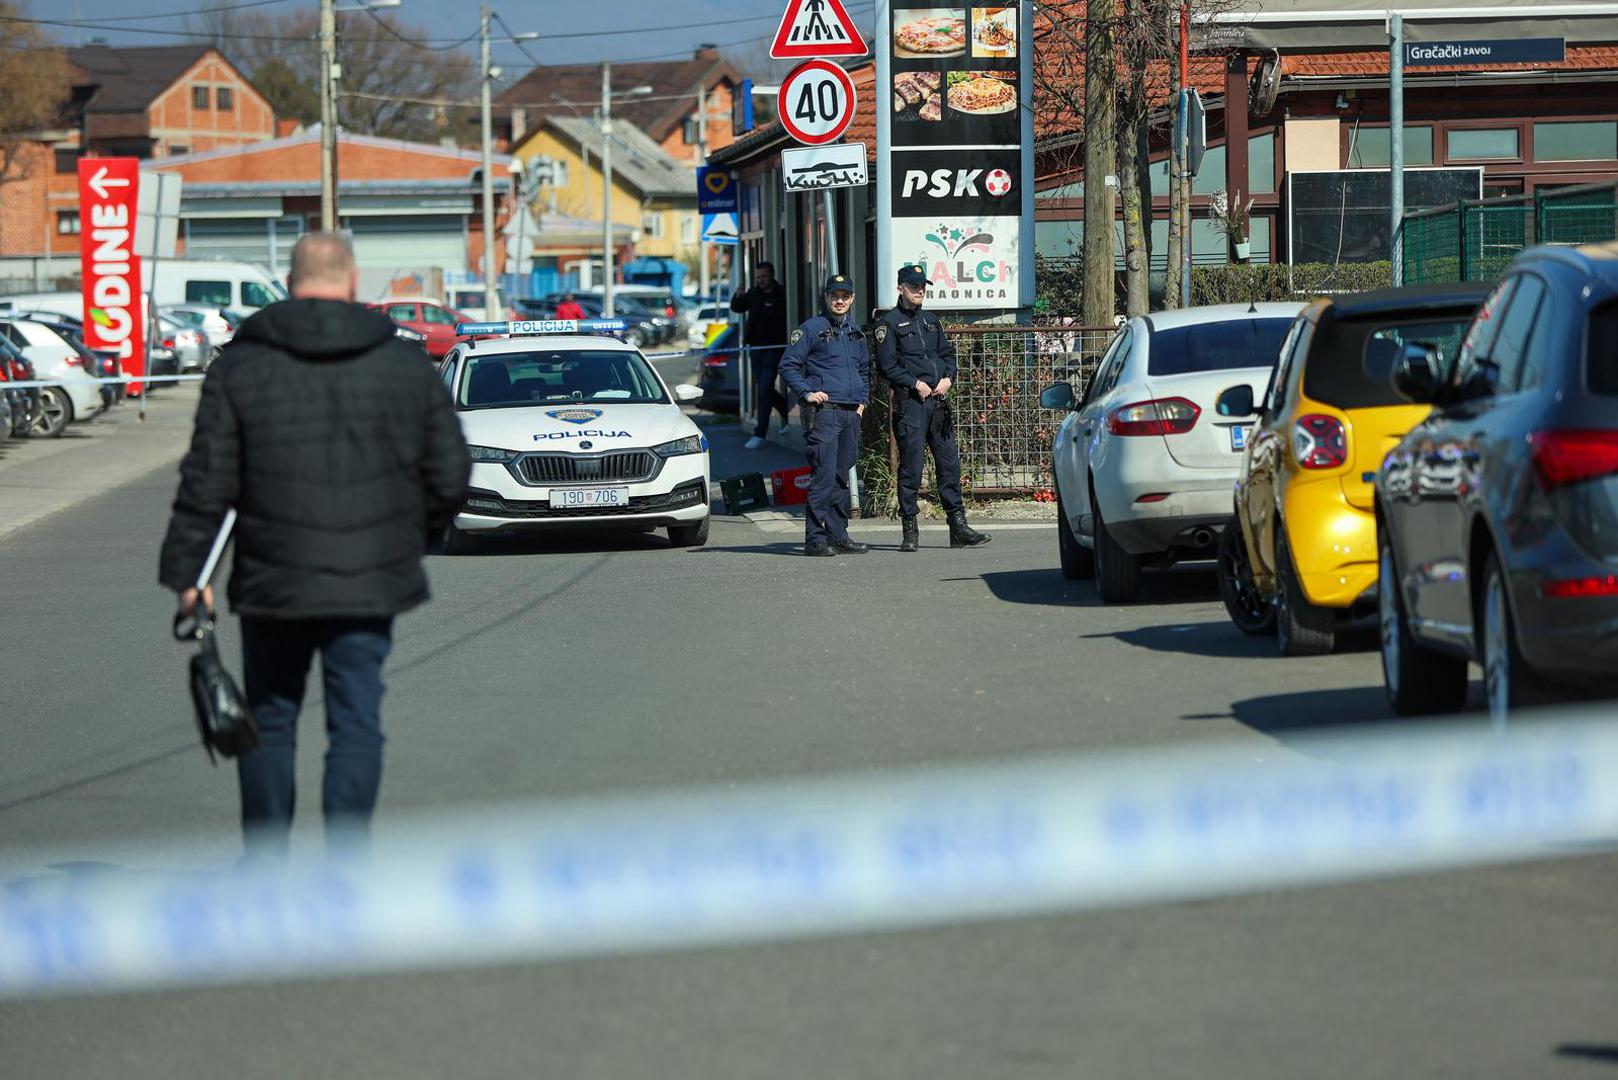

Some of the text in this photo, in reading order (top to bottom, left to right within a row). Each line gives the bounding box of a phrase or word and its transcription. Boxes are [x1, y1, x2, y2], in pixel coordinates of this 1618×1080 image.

[1411, 44, 1491, 60] Gračački ZAVOJ
[795, 79, 839, 123] 40
[926, 288, 1007, 299] RAONICA
[513, 320, 574, 332] POLICIJA
[533, 429, 633, 441] POLICIJA
[563, 490, 618, 504] 190 706
